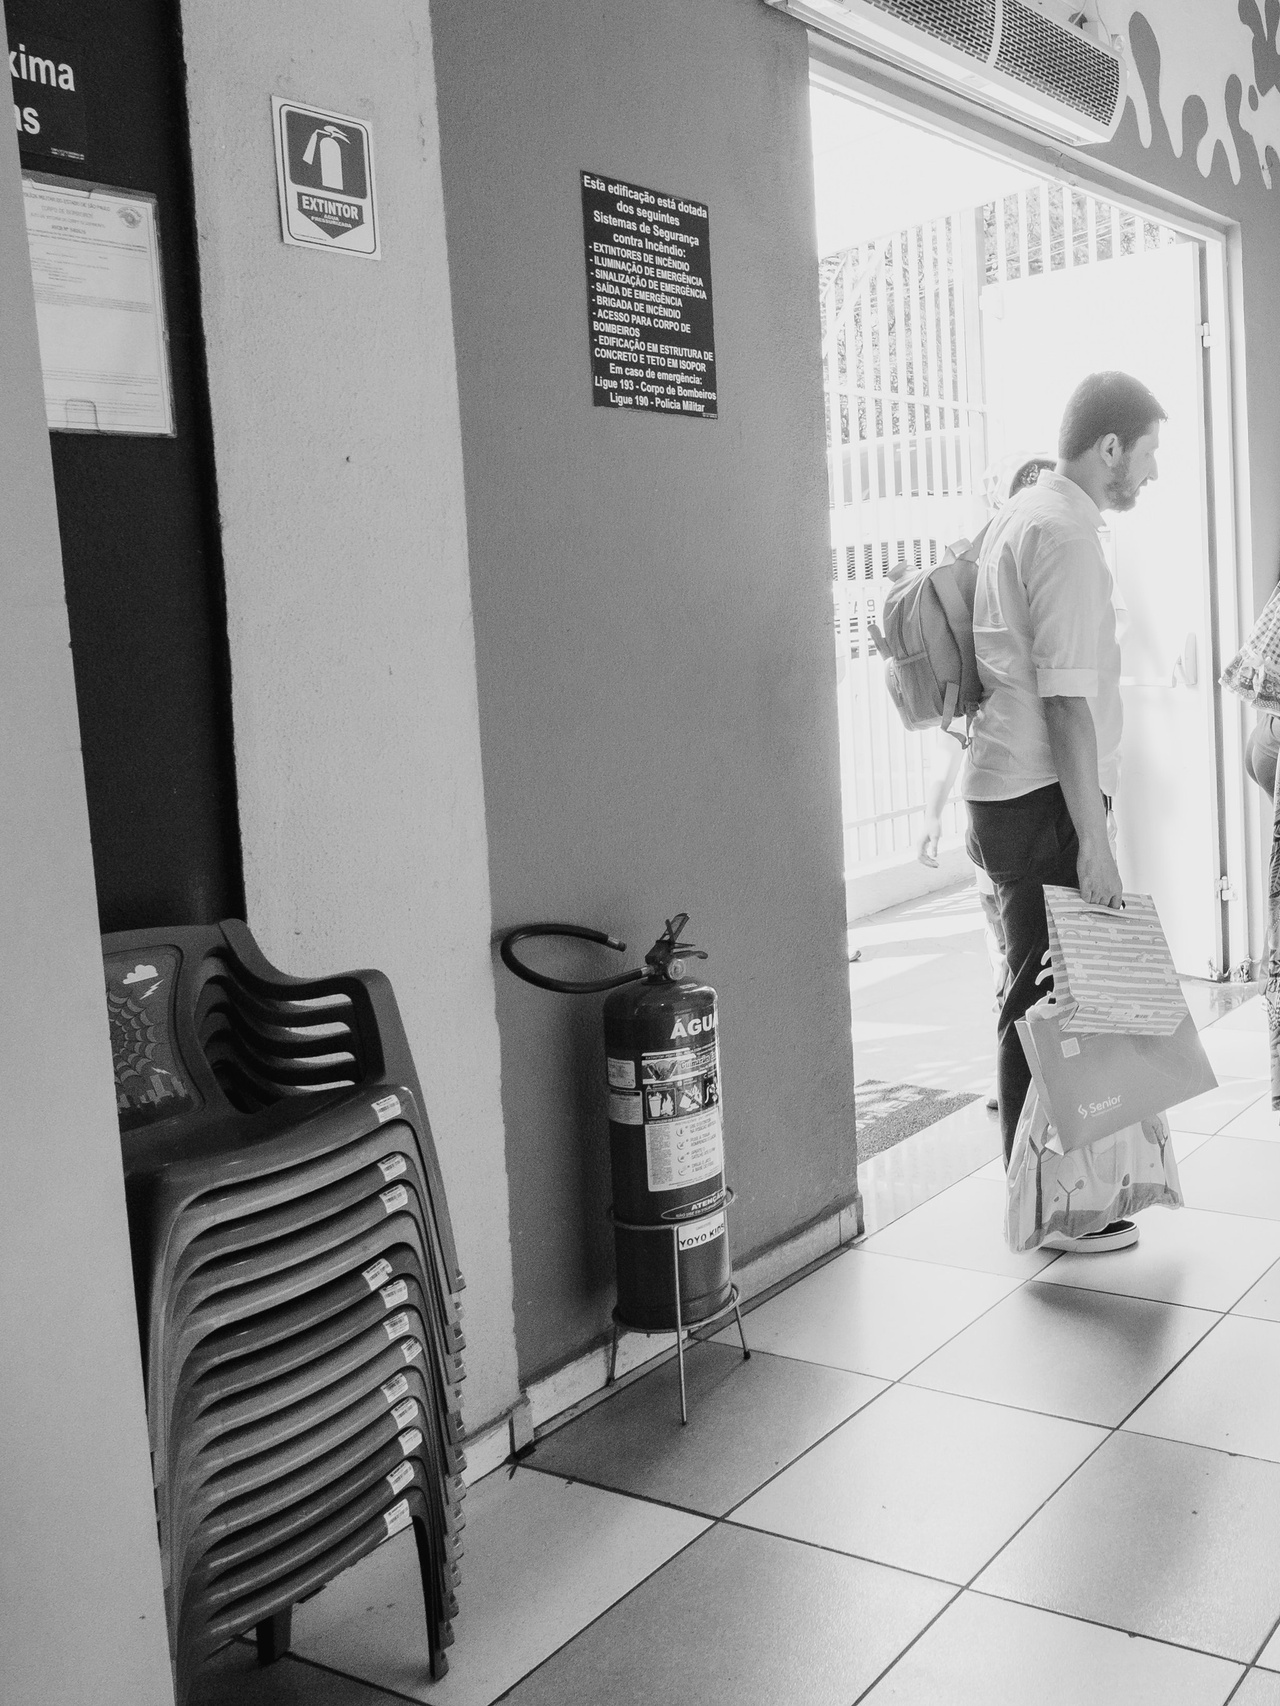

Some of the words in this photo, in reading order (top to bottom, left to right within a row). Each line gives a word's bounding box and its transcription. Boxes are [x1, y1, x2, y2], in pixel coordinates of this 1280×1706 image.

[301, 195, 359, 220] EXTINTOR
[583, 175, 606, 191] Esta
[607, 183, 655, 205] edificação
[657, 197, 676, 210] está
[678, 201, 707, 218] dotada
[616, 200, 634, 215] dos
[636, 207, 680, 226] seguintes
[593, 210, 637, 231] Sistemas
[639, 222, 651, 234] de
[653, 224, 700, 247] Segurança
[593, 242, 642, 261] EXTINTORES
[643, 253, 654, 264] DE
[655, 255, 690, 272] INCÊNDIO
[613, 233, 643, 248] contra
[645, 238, 686, 258] Incêndio:
[594, 255, 643, 274] ILUMINAÇÃO
[644, 266, 655, 277] DE
[656, 269, 703, 287] EMERGÊNCIA
[595, 269, 647, 288] SINALIZAÇÃO
[648, 279, 659, 290] DE
[660, 282, 707, 300] EMERGÊNCIA
[596, 282, 620, 296] SAÍDA
[622, 287, 633, 298] DE
[634, 289, 683, 307] EMERGÊNCIA
[596, 295, 633, 311] BRIGADA
[634, 302, 645, 313] DE
[646, 304, 681, 319] INCÊNDIO
[593, 321, 640, 338] BOMBEIROS
[597, 309, 630, 323] ACESSO
[631, 314, 652, 327] PARA
[653, 318, 680, 331] CORPO
[680, 323, 691, 333] DE
[594, 347, 638, 363] CONCRETO
[640, 353, 645, 364] E
[646, 355, 666, 366] TETO
[667, 357, 678, 368] EM
[679, 360, 707, 372] ISOPOR
[598, 335, 646, 351] EDIFICAÇÃO
[647, 342, 658, 353] EM
[659, 344, 702, 360] ESTRUTURA
[703, 351, 714, 361] DE
[609, 363, 623, 375] Em
[624, 366, 644, 377] caso
[645, 368, 656, 379] de
[657, 372, 702, 385] emergência:
[594, 375, 618, 389] Ligue
[619, 379, 634, 391] 193
[640, 381, 665, 395] Corpo
[666, 385, 676, 396] de
[677, 386, 717, 400] Bombeiros
[609, 392, 633, 406] Ligue
[634, 395, 649, 406] 190
[682, 400, 705, 412] Militar
[1089, 1094, 1121, 1114] Senior
[679, 1233, 707, 1248] YOYO
